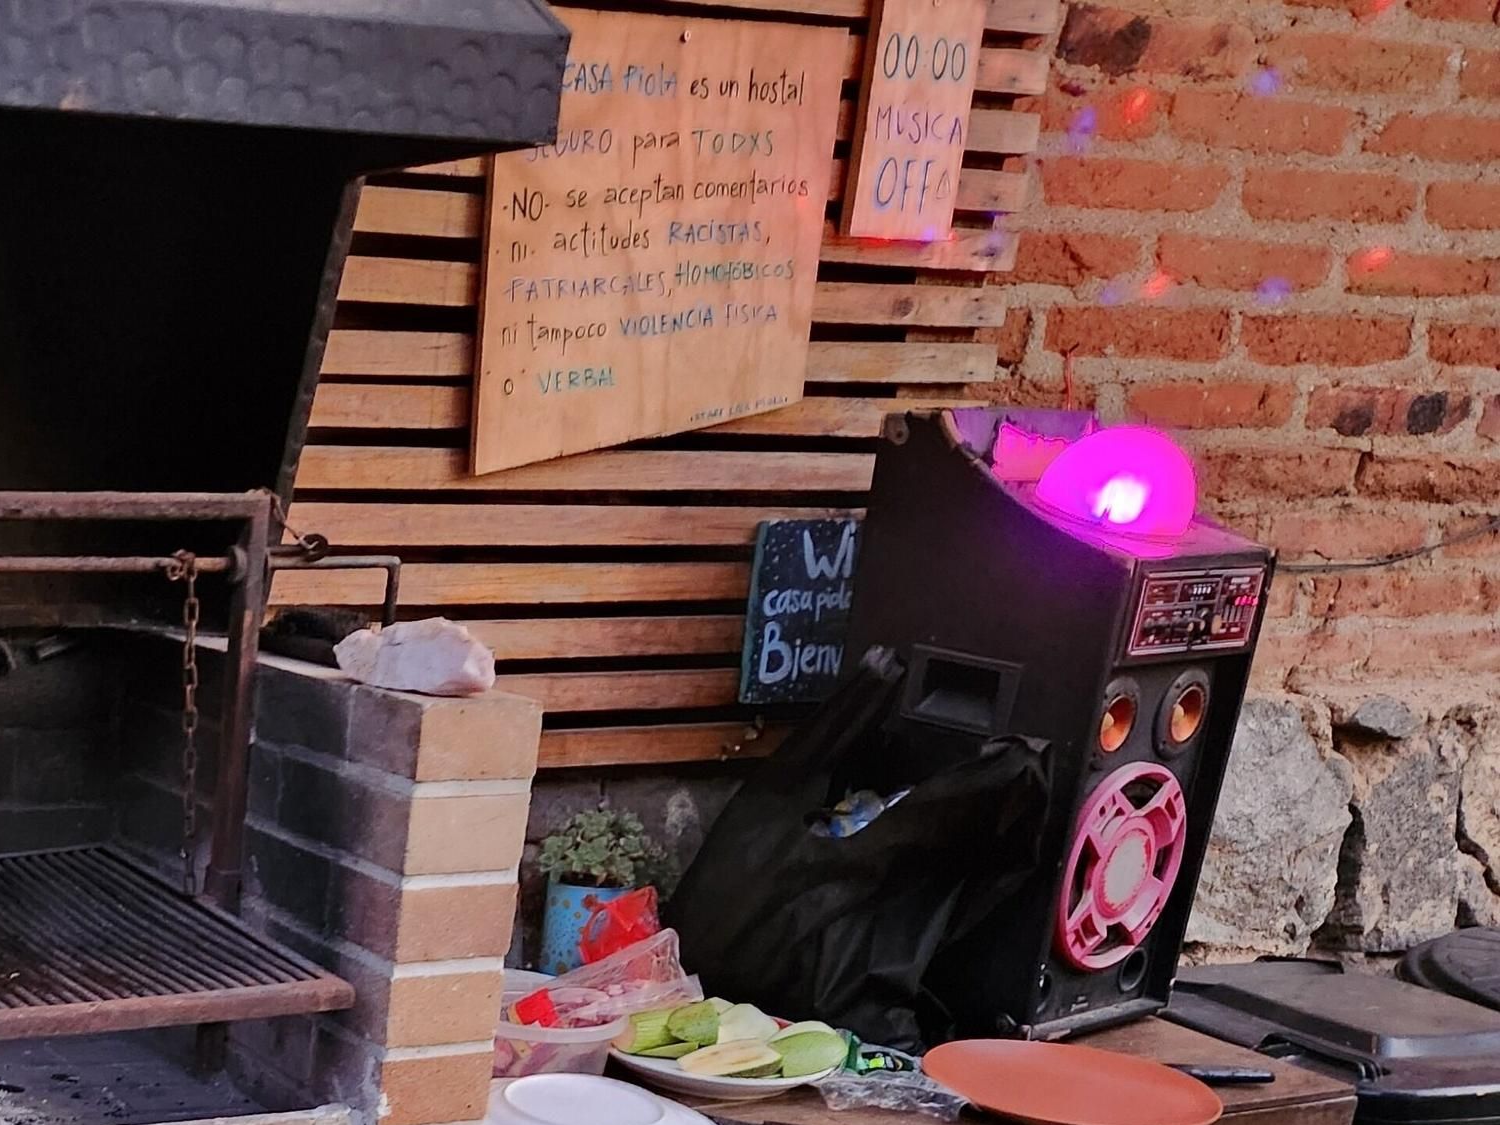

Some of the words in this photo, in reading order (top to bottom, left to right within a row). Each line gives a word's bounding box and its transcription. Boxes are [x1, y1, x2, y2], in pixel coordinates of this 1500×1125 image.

[561, 62, 613, 94] CASA
[690, 78, 709, 101] es
[719, 79, 740, 98] un
[747, 68, 805, 106] hostal
[632, 131, 680, 169] para
[692, 128, 774, 157] TODXS
[565, 189, 588, 208] se
[603, 172, 685, 219] aceptan
[692, 169, 809, 205] comentarios
[553, 219, 651, 258] actitudes
[502, 321, 518, 346] ni
[527, 313, 607, 355] tampoco
[618, 306, 714, 337] VIOLENCIA
[536, 367, 616, 395] VERBAL
[758, 621, 844, 684] Bienv
